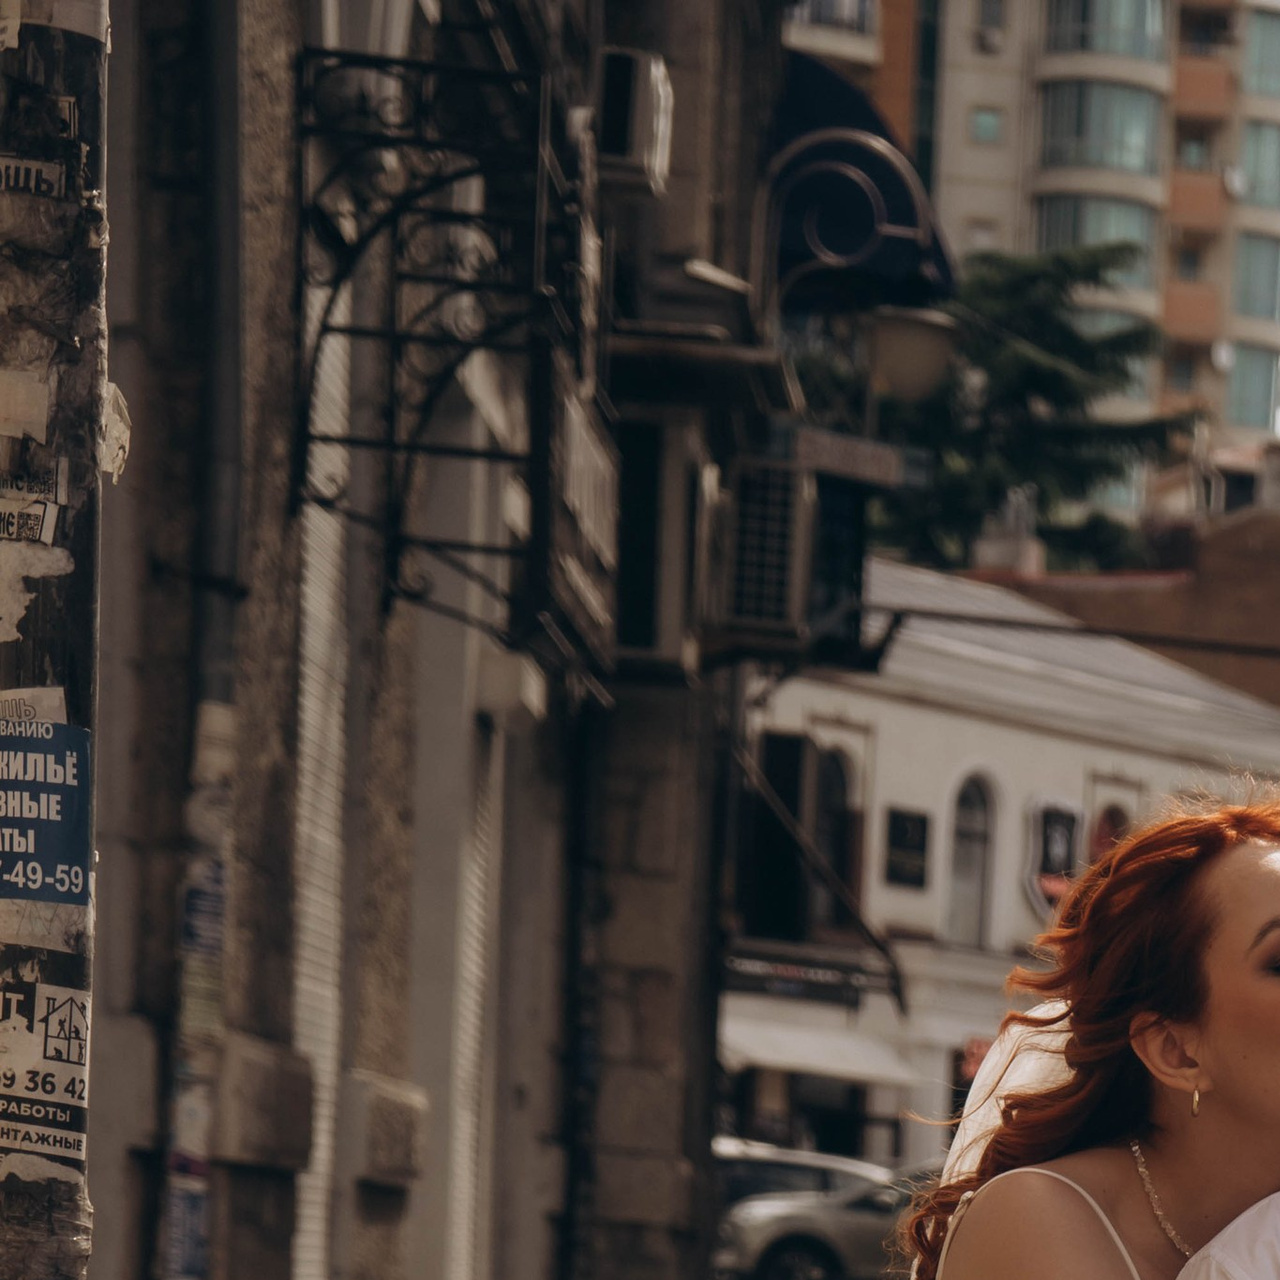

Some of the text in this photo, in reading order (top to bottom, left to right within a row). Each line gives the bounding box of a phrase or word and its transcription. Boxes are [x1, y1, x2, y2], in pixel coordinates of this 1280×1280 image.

[0, 165, 55, 198] ЩЬ
[0, 828, 35, 854] ТЫ
[0, 860, 84, 894] -49-59
[24, 1069, 57, 1095] 36
[63, 1076, 86, 1101] 42
[0, 1100, 71, 1123] РАБОТЫ
[0, 1126, 83, 1152] НТАЖНЫЕ
